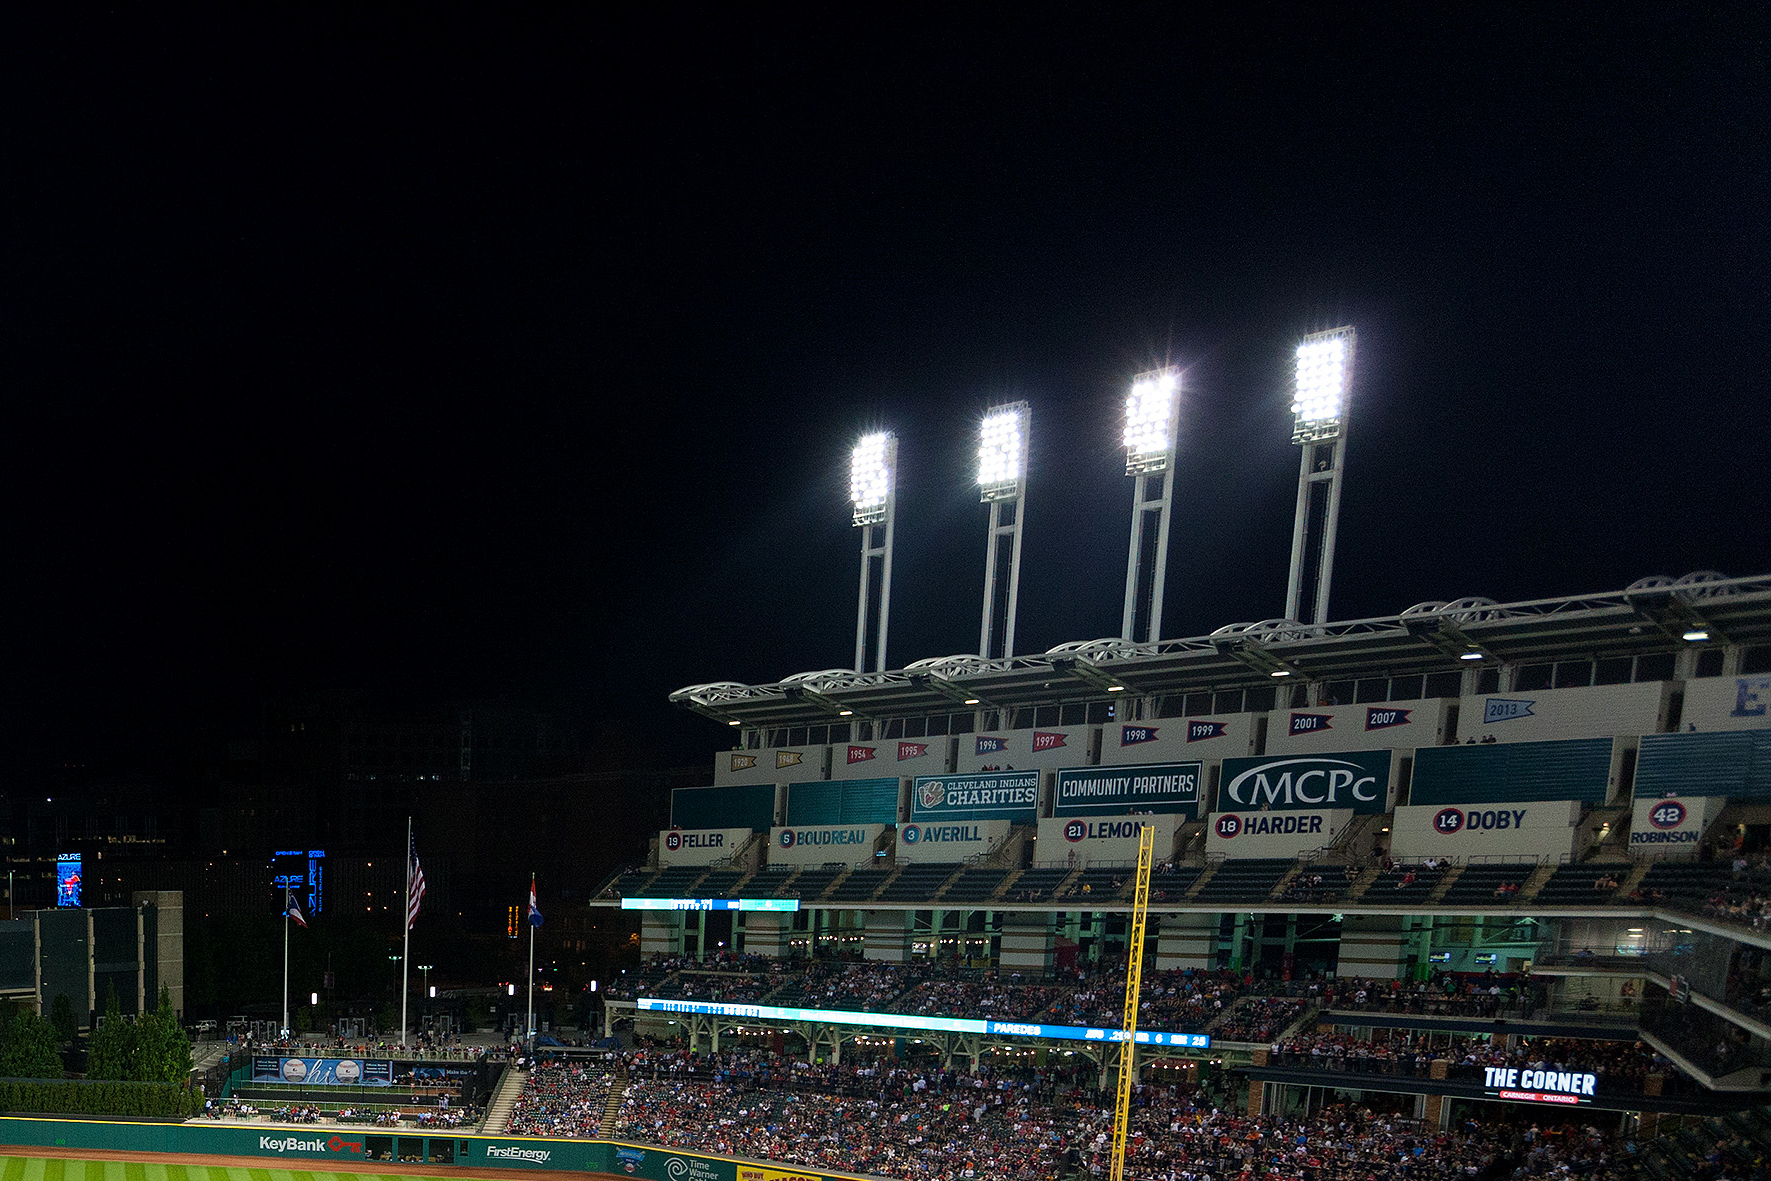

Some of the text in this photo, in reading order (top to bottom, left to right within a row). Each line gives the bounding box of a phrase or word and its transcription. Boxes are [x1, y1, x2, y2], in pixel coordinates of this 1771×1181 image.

[1489, 703, 1518, 717] 2013
[1293, 717, 1317, 730] 2001
[1370, 711, 1396, 725] 2007
[1125, 729, 1147, 741] 1998
[1192, 724, 1214, 737] 1999
[979, 739, 997, 750] 1996
[1036, 736, 1055, 747] 1997
[850, 749, 866, 760] 1954
[901, 745, 918, 756] 1995
[947, 777, 1036, 791] CLEVELAND INDIANS
[1062, 773, 1195, 798] COMMUNITY PARTNERS
[1249, 769, 1377, 806] MCPc
[947, 788, 1036, 806] CHARITIES
[1439, 810, 1526, 831] 14 DOBY
[1652, 808, 1678, 823] 42
[1068, 820, 1145, 839] 21 LEMON
[1221, 815, 1322, 836] 18 HARDER
[668, 833, 724, 848] 19 FELLER
[783, 829, 865, 846] 5 BOUDREAU
[908, 825, 982, 843] 3 AVERILL
[1631, 831, 1699, 843] ROBINSON
[307, 1059, 336, 1085] hi
[1484, 1066, 1596, 1096] THE CORNER
[1502, 1092, 1575, 1103] CARNEGIE ONTARIO
[259, 1137, 325, 1152] KeyBank
[487, 1146, 550, 1161] FirstEnergy
[689, 1160, 709, 1170] Time
[689, 1169, 718, 1180] Warner
